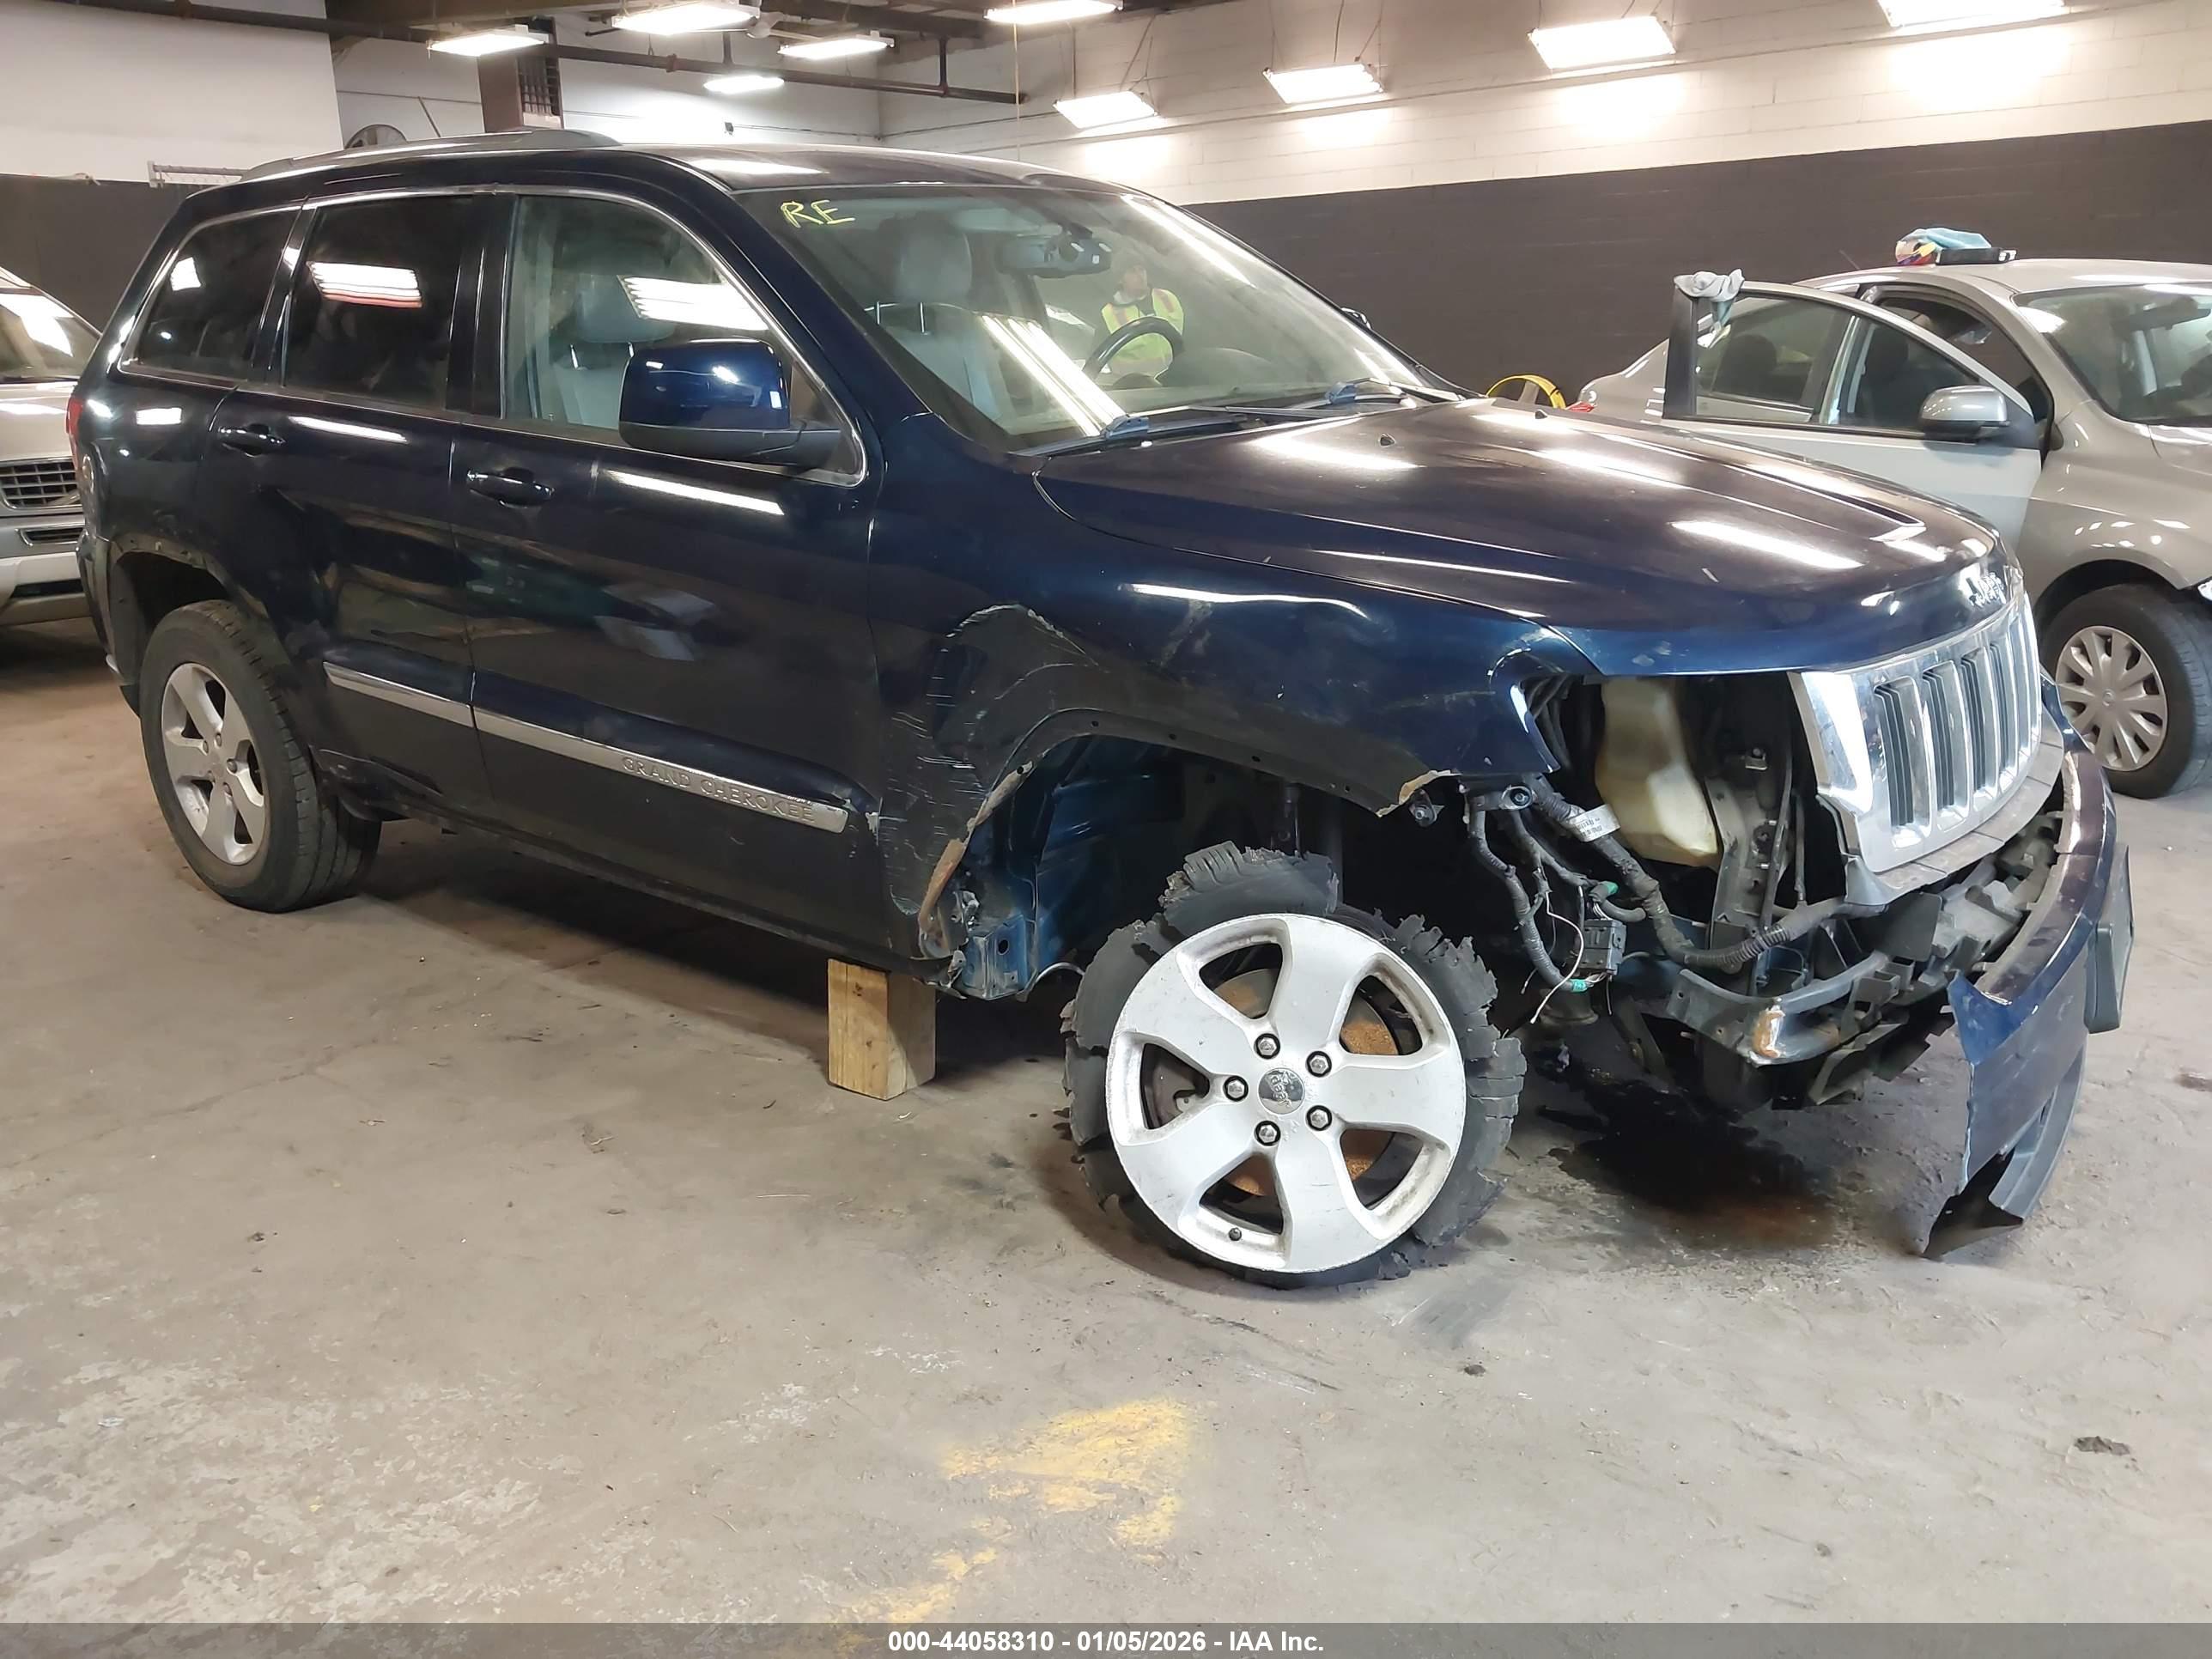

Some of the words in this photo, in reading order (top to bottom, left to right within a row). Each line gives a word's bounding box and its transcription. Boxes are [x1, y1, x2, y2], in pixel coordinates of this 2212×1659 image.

[780, 199, 855, 228] RE
[622, 756, 691, 789] GRAND
[700, 778, 816, 824] CHEROKEE
